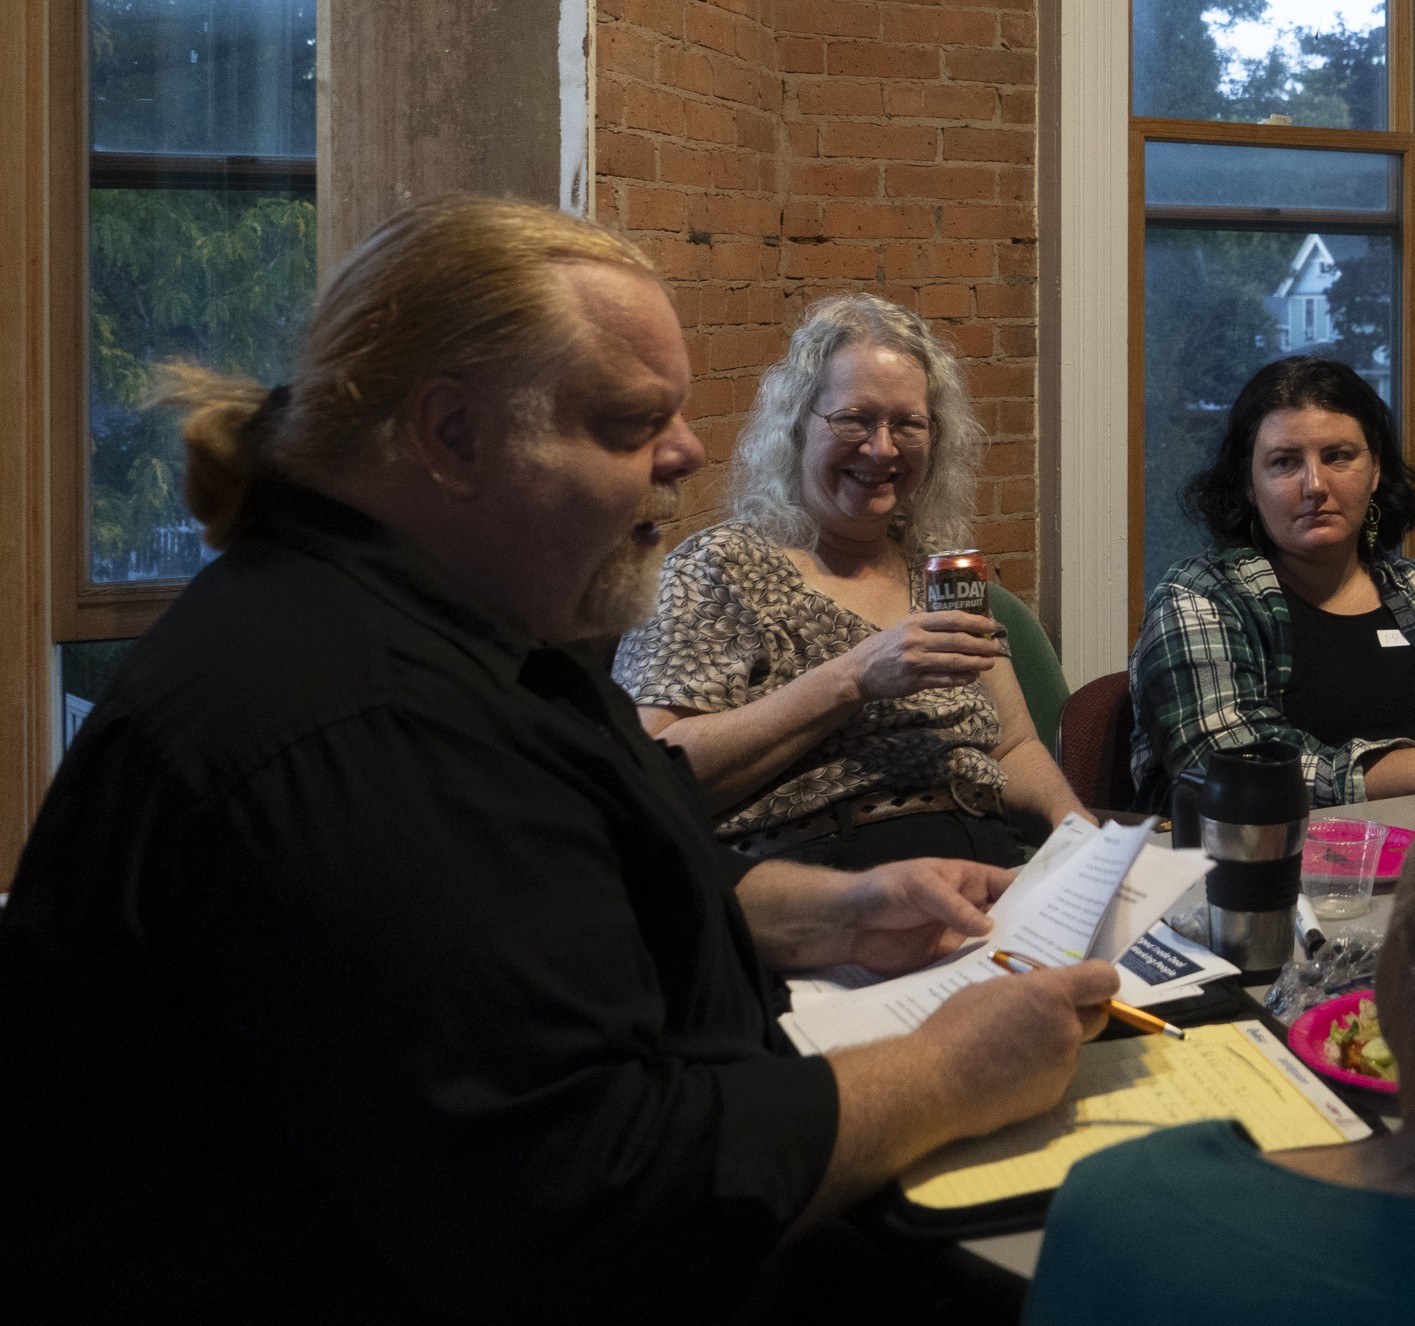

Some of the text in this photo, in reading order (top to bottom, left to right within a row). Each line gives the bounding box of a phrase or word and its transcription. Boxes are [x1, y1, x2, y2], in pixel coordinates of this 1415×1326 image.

[928, 581, 986, 602] ALL DAY
[932, 599, 983, 610] GRAPEFRUIT
